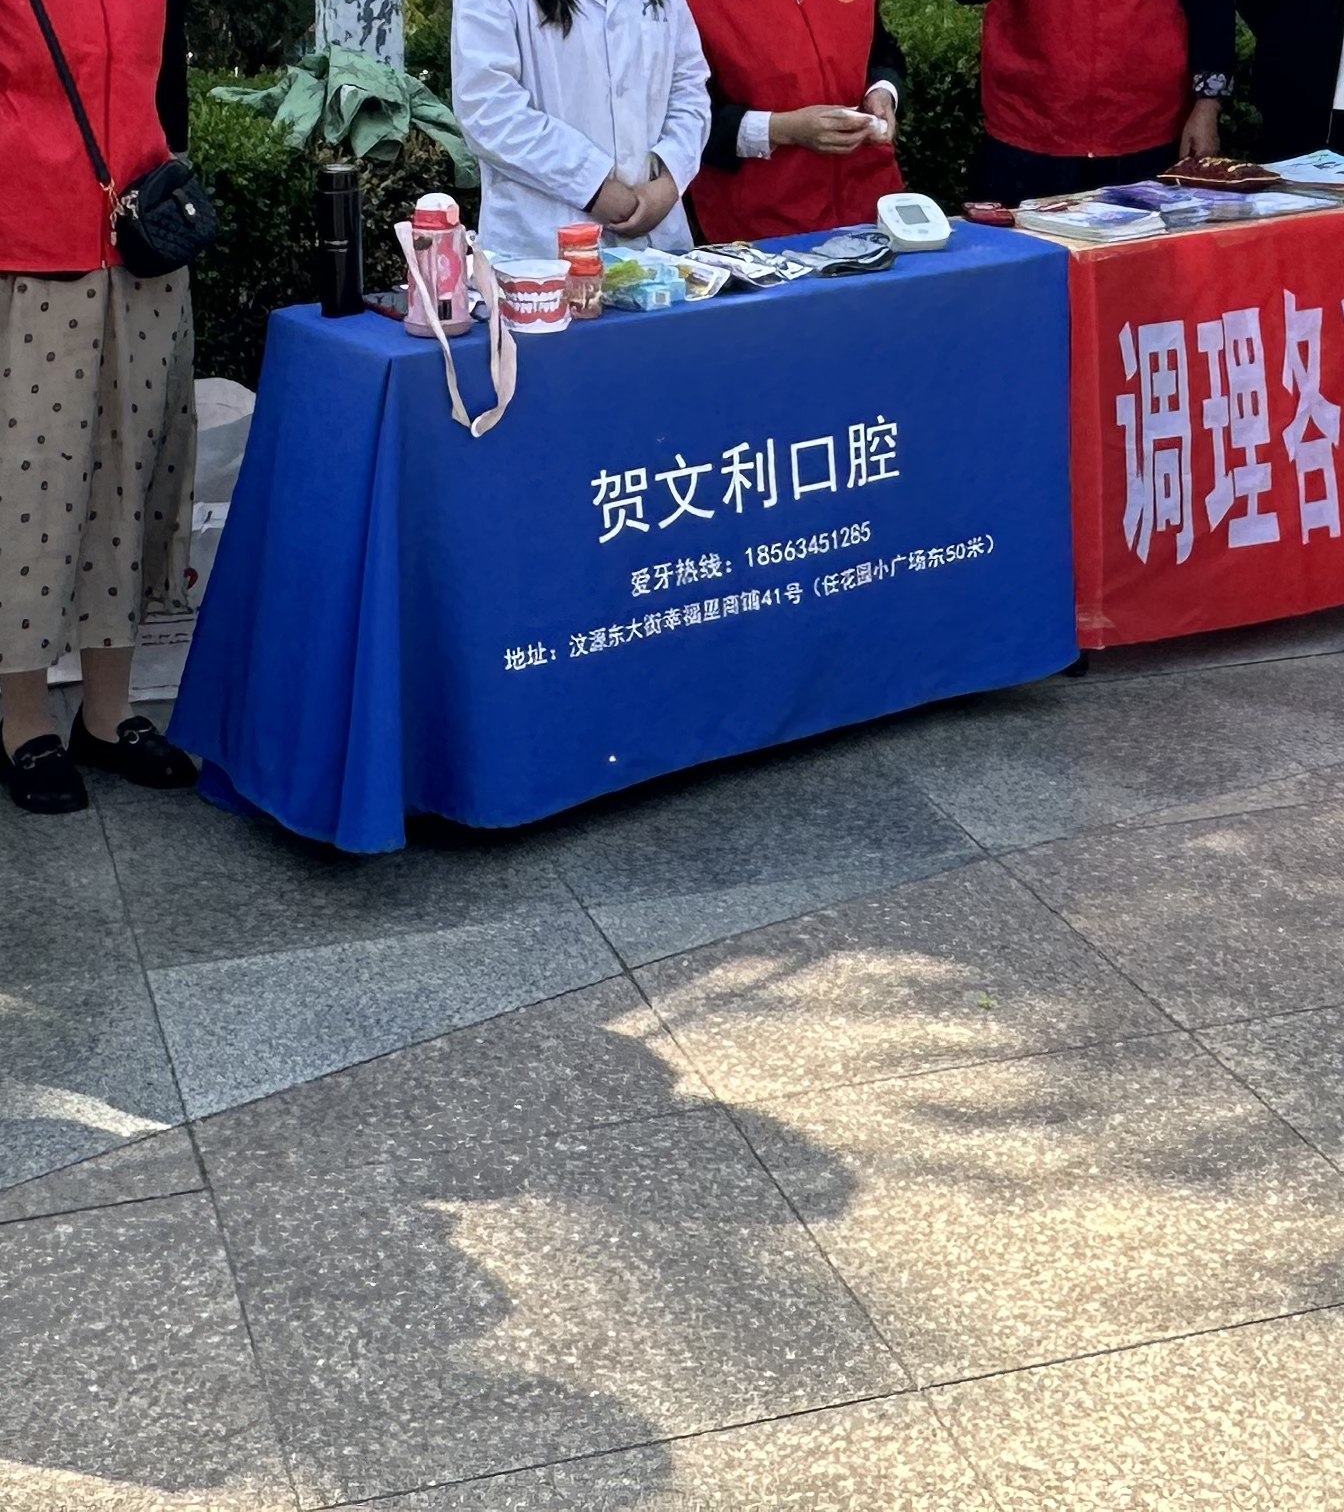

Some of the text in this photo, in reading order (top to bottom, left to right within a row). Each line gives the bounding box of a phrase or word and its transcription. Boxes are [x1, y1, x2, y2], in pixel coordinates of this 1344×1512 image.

[590, 414, 900, 544] 贺文利口腔
